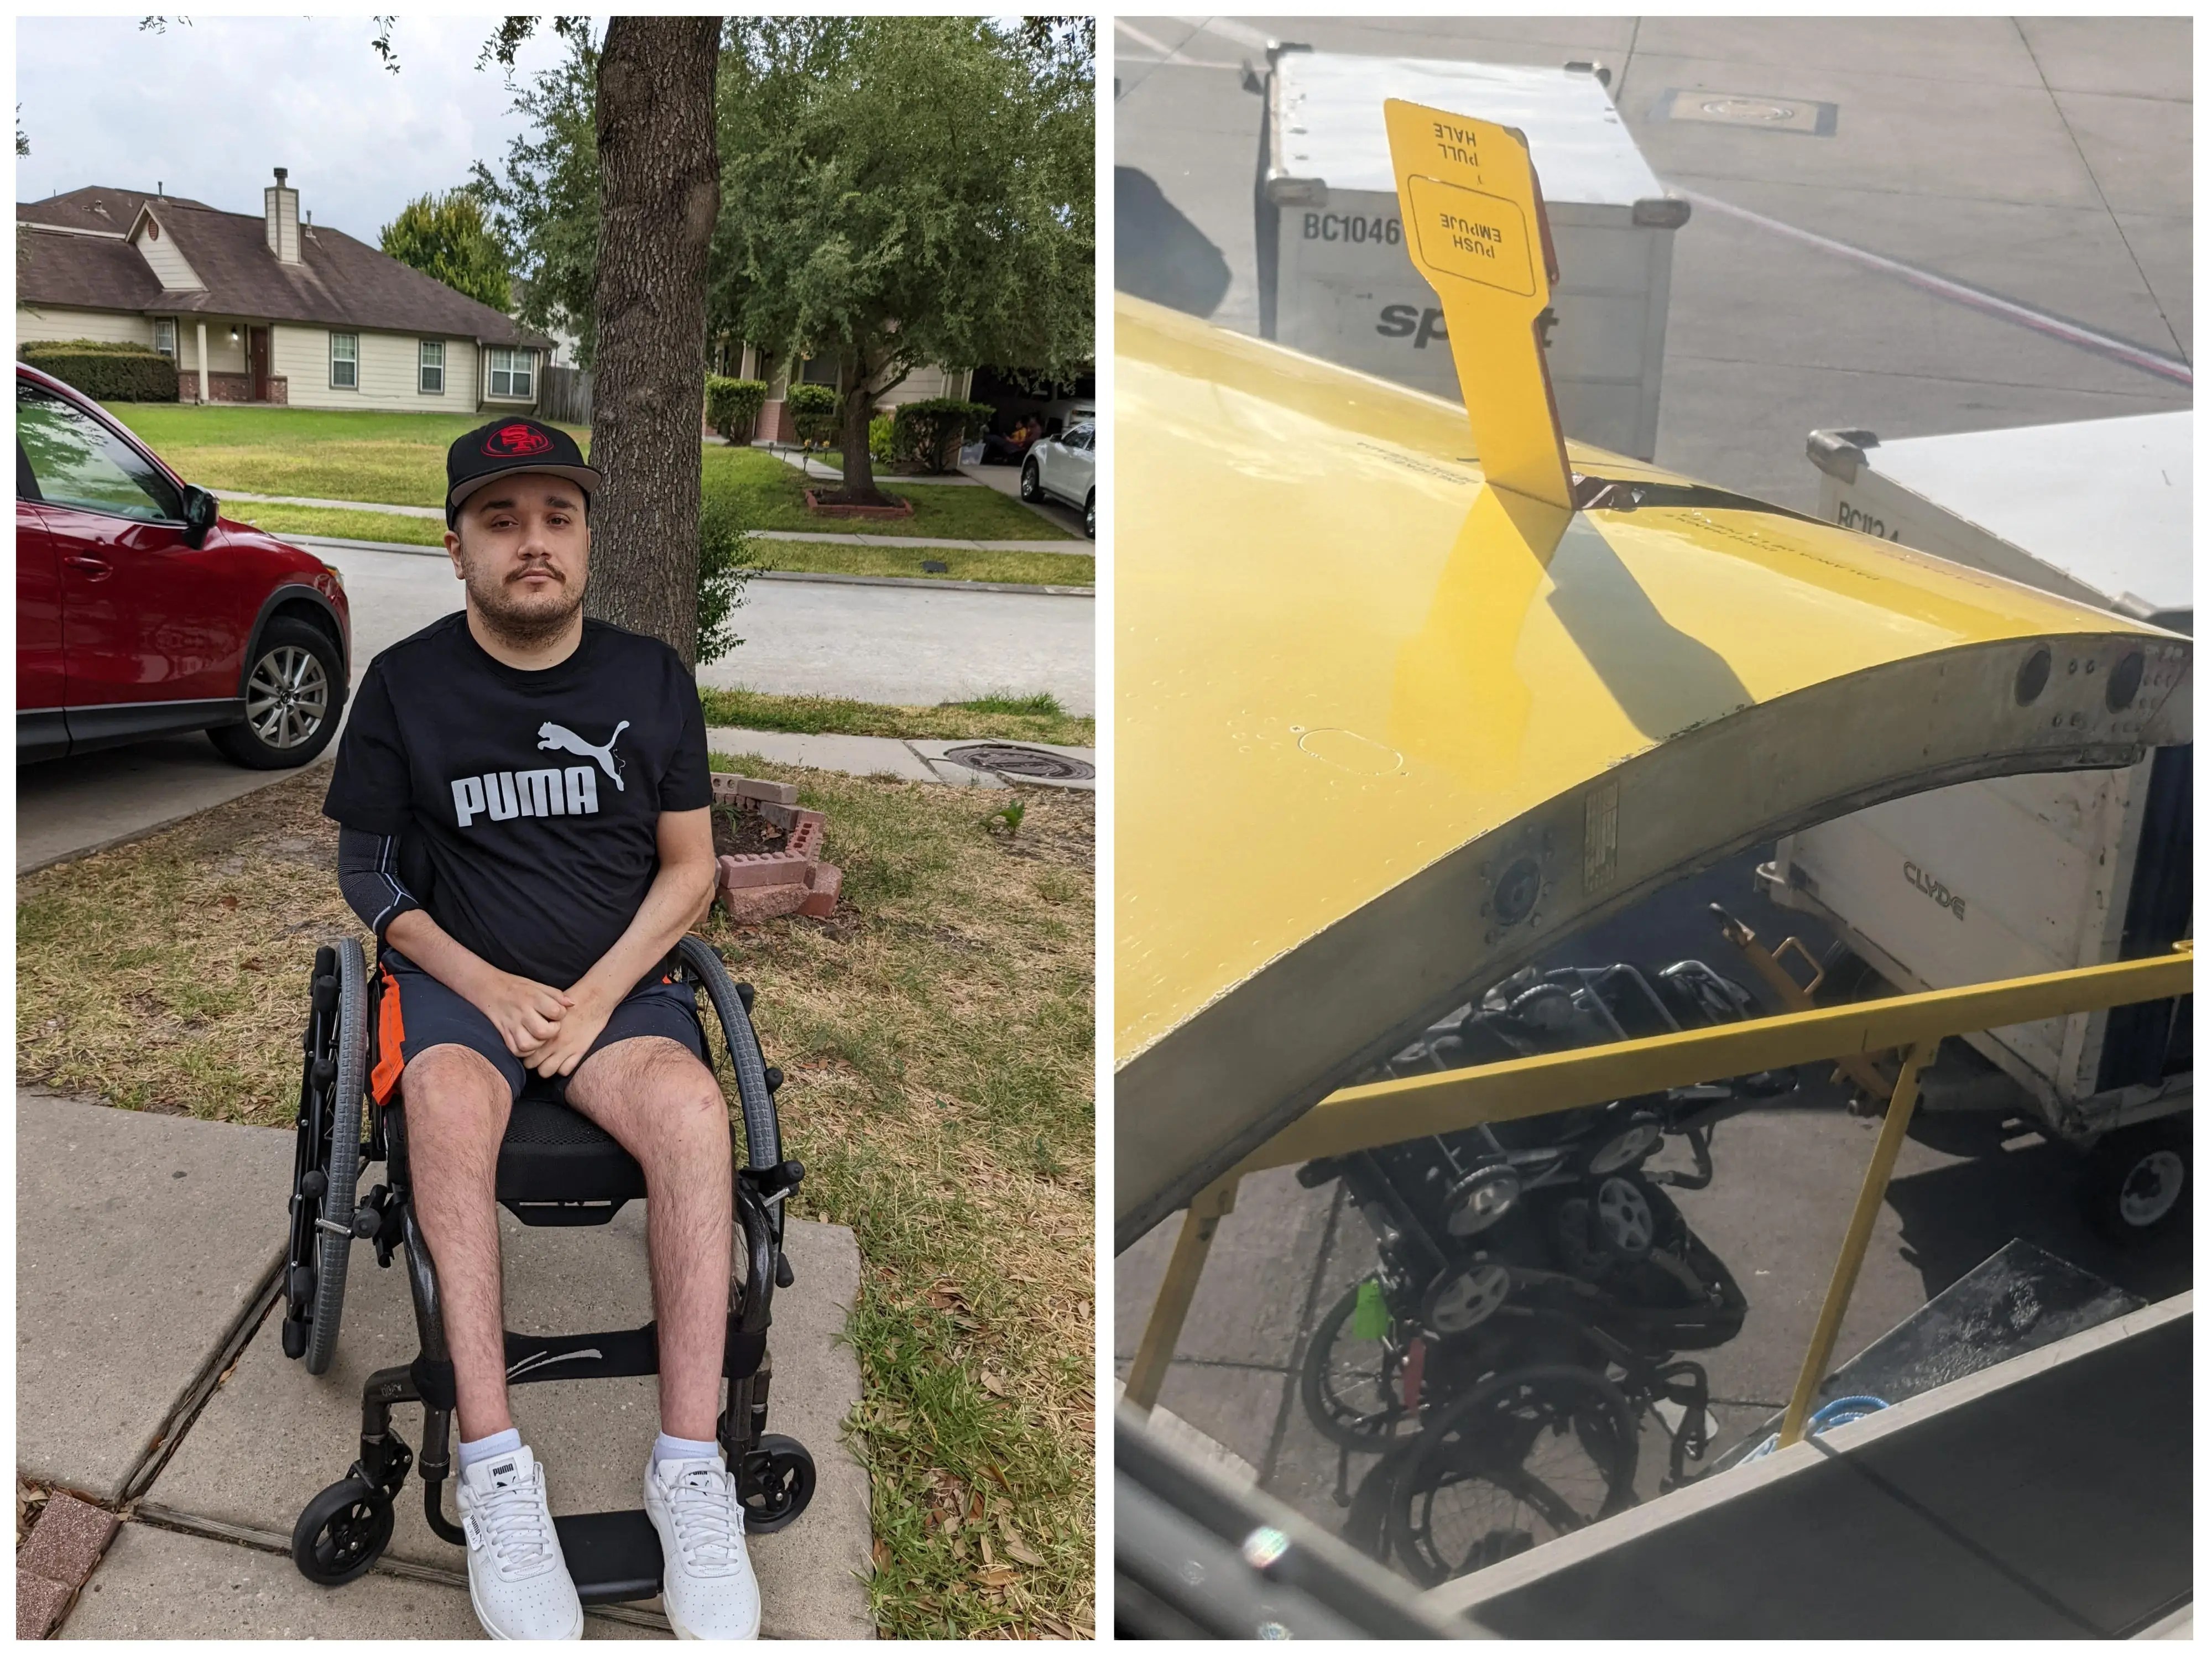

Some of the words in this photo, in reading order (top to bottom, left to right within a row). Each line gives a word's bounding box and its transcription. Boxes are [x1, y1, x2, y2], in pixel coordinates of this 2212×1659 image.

[1433, 122, 1477, 147] HALE
[1437, 143, 1479, 167] PULL
[1303, 212, 1401, 245] BC1046
[1439, 213, 1502, 243] EMPUJE
[1453, 234, 1495, 259] PUSH
[1376, 304, 1560, 349] spt
[451, 766, 598, 827] PUMA
[1903, 861, 1965, 921] CLYDE
[493, 1463, 514, 1477] PUMA
[470, 1515, 481, 1535] PUMA
